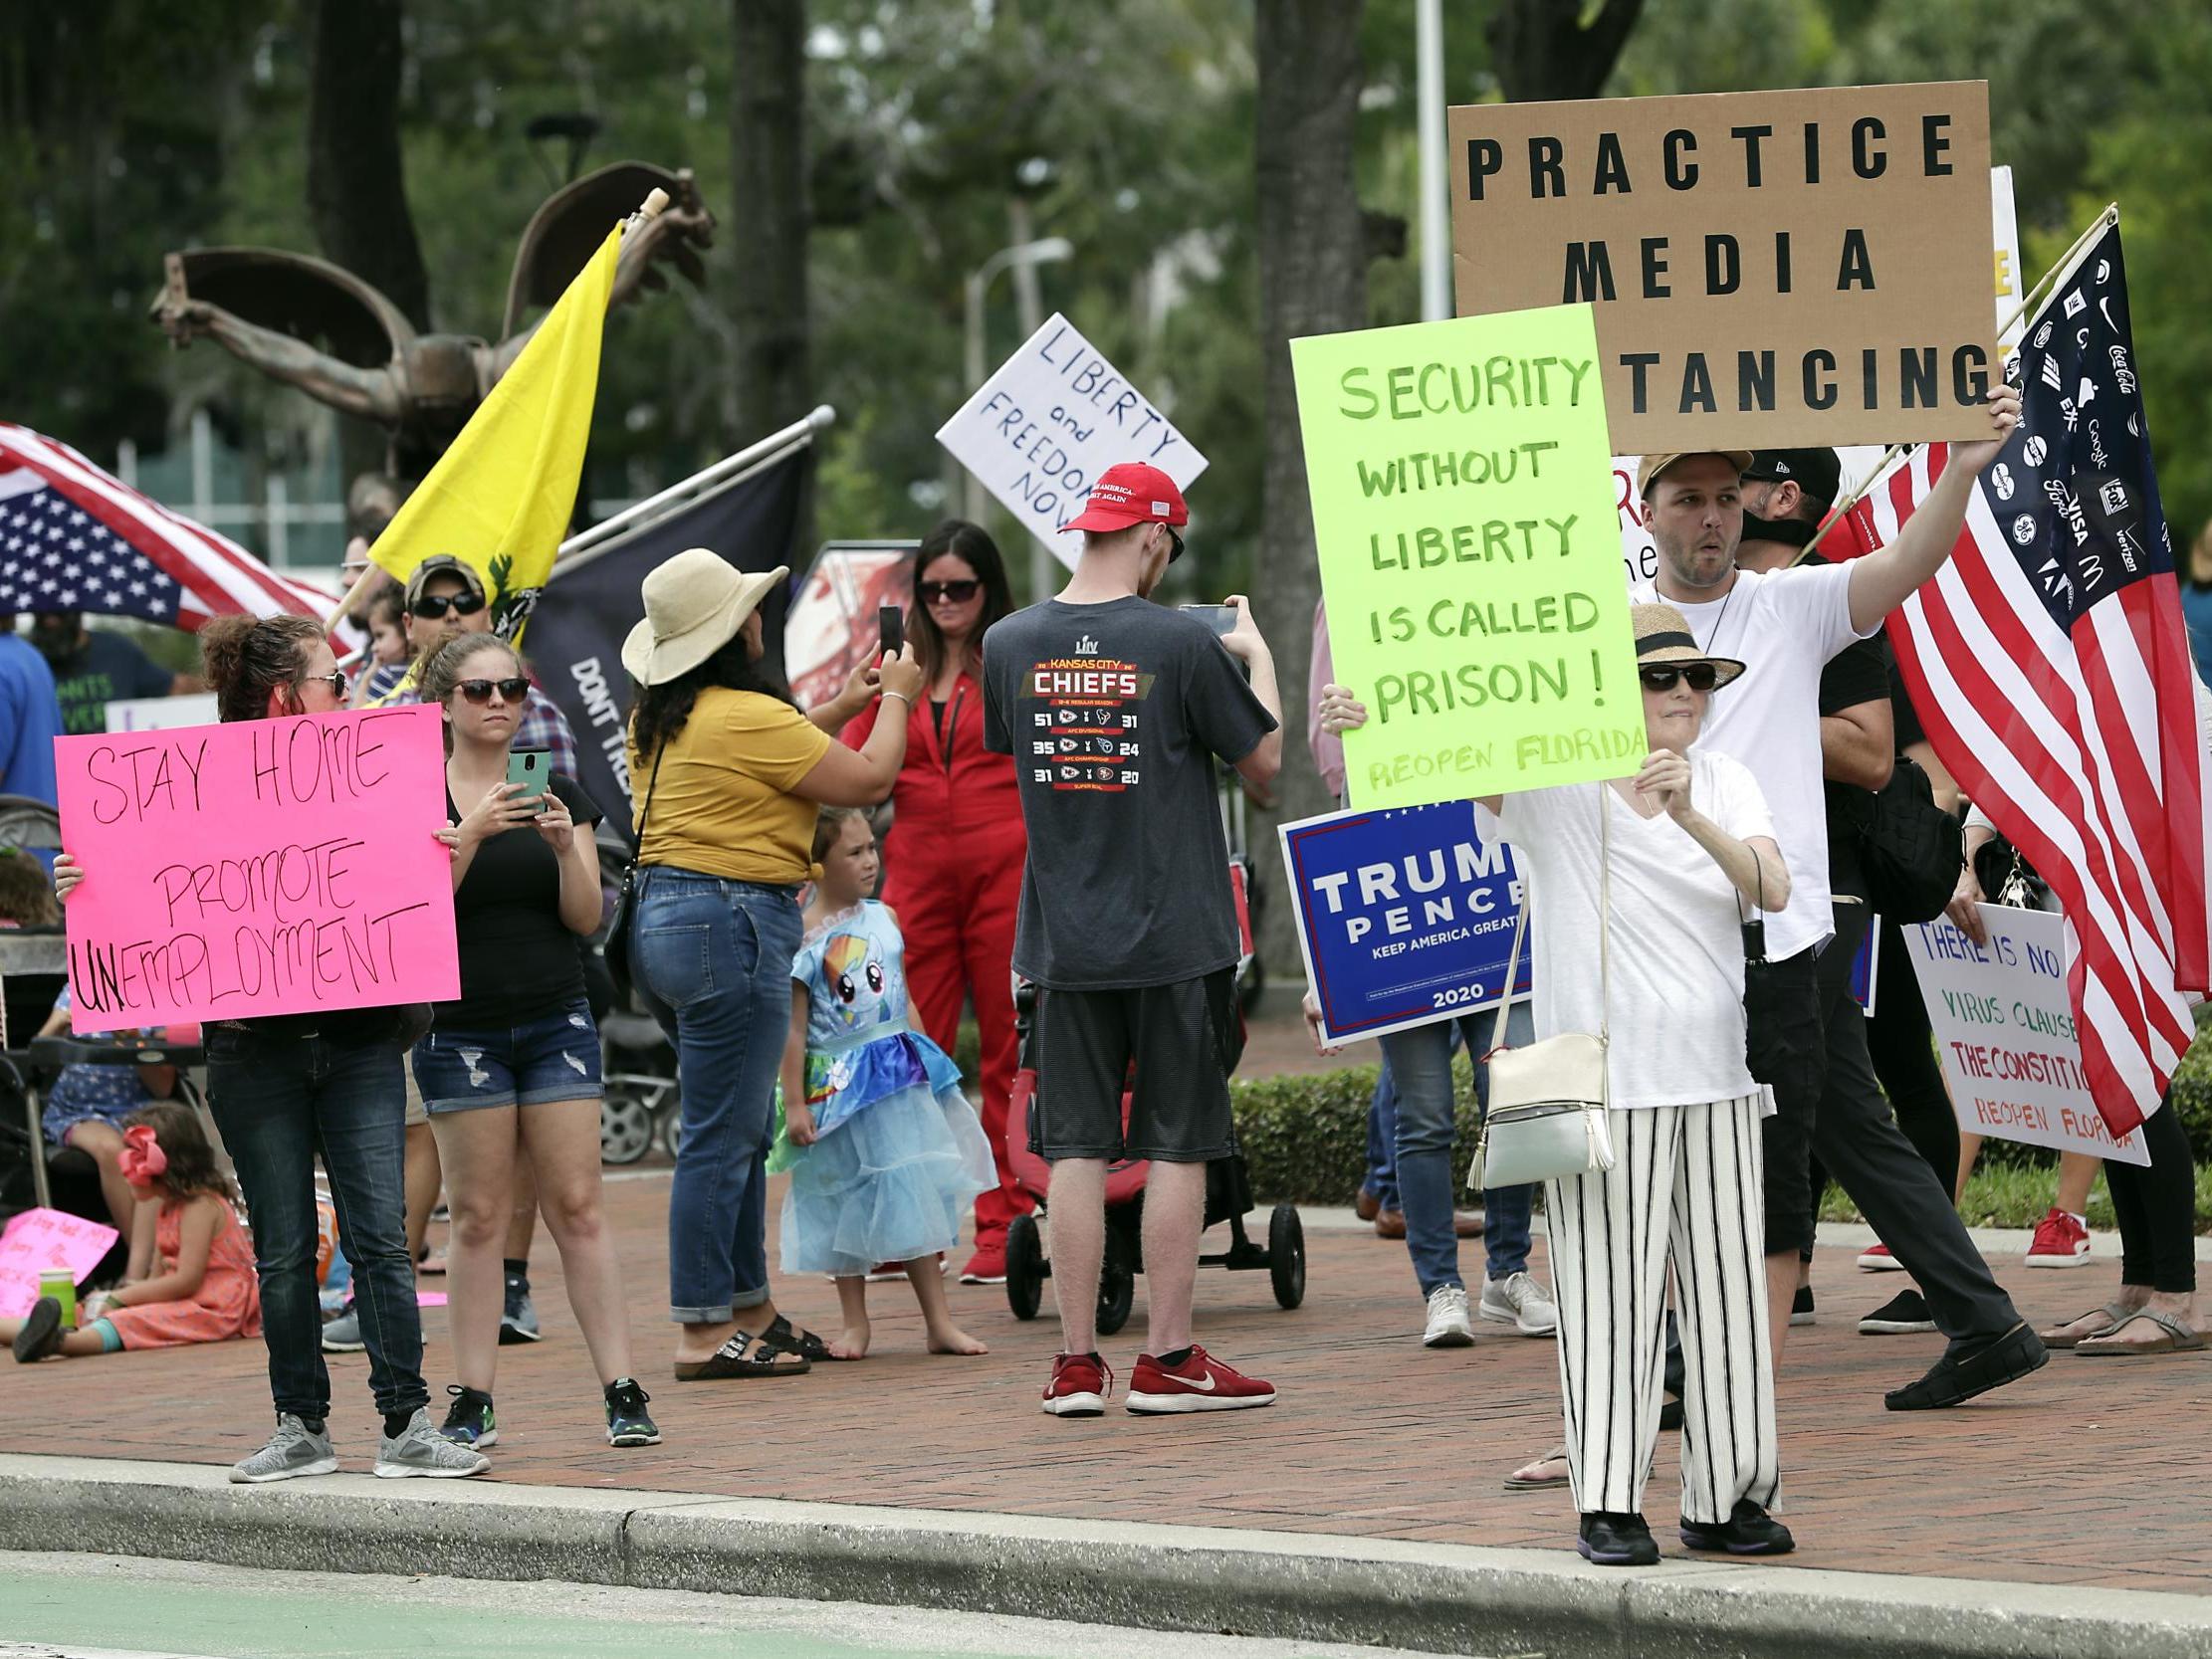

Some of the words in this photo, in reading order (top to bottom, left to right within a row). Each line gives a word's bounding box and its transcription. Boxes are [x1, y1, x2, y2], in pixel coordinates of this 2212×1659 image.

[1467, 114, 1953, 201] PRACTICE
[1562, 228, 1876, 305] MEDIA
[1994, 250, 2012, 297] E
[1039, 326, 1178, 459] LIBERTY
[1339, 355, 1594, 421] SECURITY
[1619, 343, 1991, 414] TANCING
[1049, 406, 1094, 443] and
[2089, 418, 2108, 470] Google
[1357, 440, 1559, 498] WITHOUT
[2027, 436, 2044, 467] PEPSI
[1102, 493, 1127, 504] AGAIN
[2068, 493, 2089, 547] VISA
[1370, 514, 1578, 570] LIBERTY
[2115, 529, 2137, 573] verizon
[1370, 606, 1417, 645] IS
[1427, 592, 1599, 638] CALLED
[1034, 672, 1137, 695] CHIEFS
[1051, 659, 1095, 669] KANSAS
[1096, 659, 1121, 669] CITY
[1034, 713, 1052, 726] 51
[1121, 715, 1138, 728] 31
[88, 738, 209, 825] STAY
[253, 711, 417, 806] HOME
[601, 725, 634, 802] TRE
[1033, 740, 1055, 754] 35
[1119, 742, 1140, 756] 24
[1369, 742, 1493, 791] REOPEN
[1516, 726, 1648, 771] FLORIDA
[1033, 768, 1052, 782] 31
[1121, 770, 1139, 784] 20
[153, 837, 365, 928] PROMOTE
[1312, 842, 1507, 914] TRUM
[1346, 880, 1525, 944] PENCE
[70, 902, 430, 1013] UNEMPLOYMENT
[1372, 941, 1407, 960] KEEP
[1410, 927, 1470, 951] AMERICA
[1992, 934, 2017, 966] IS
[2026, 940, 2060, 978] NO
[1432, 982, 1484, 1008] 2020
[1941, 988, 2005, 1024] VIRUS
[1974, 1097, 2049, 1132] REOPEN
[2061, 1108, 2136, 1151] FLORA
